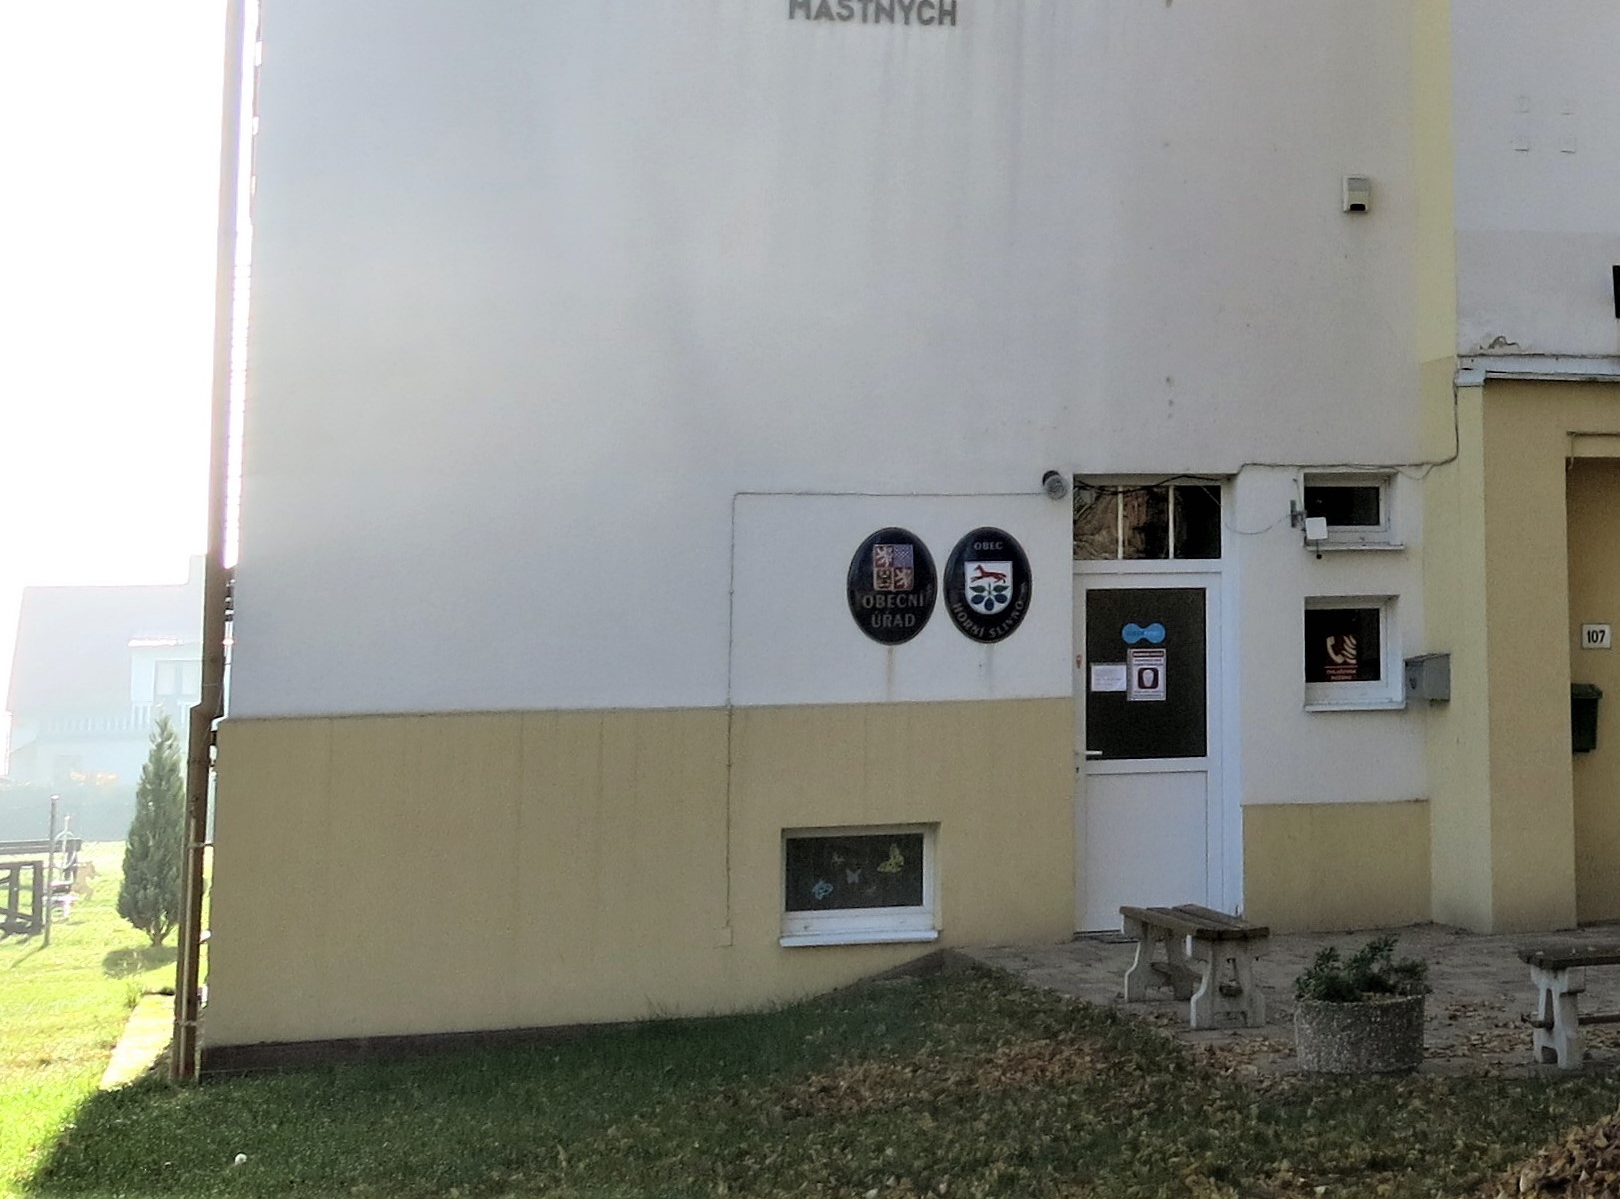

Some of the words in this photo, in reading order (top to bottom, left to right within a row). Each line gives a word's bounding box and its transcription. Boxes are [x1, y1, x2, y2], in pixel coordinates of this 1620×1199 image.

[974, 541, 1003, 551] OBEC
[871, 611, 916, 628] ÚŘAD
[1587, 630, 1606, 644] 107
